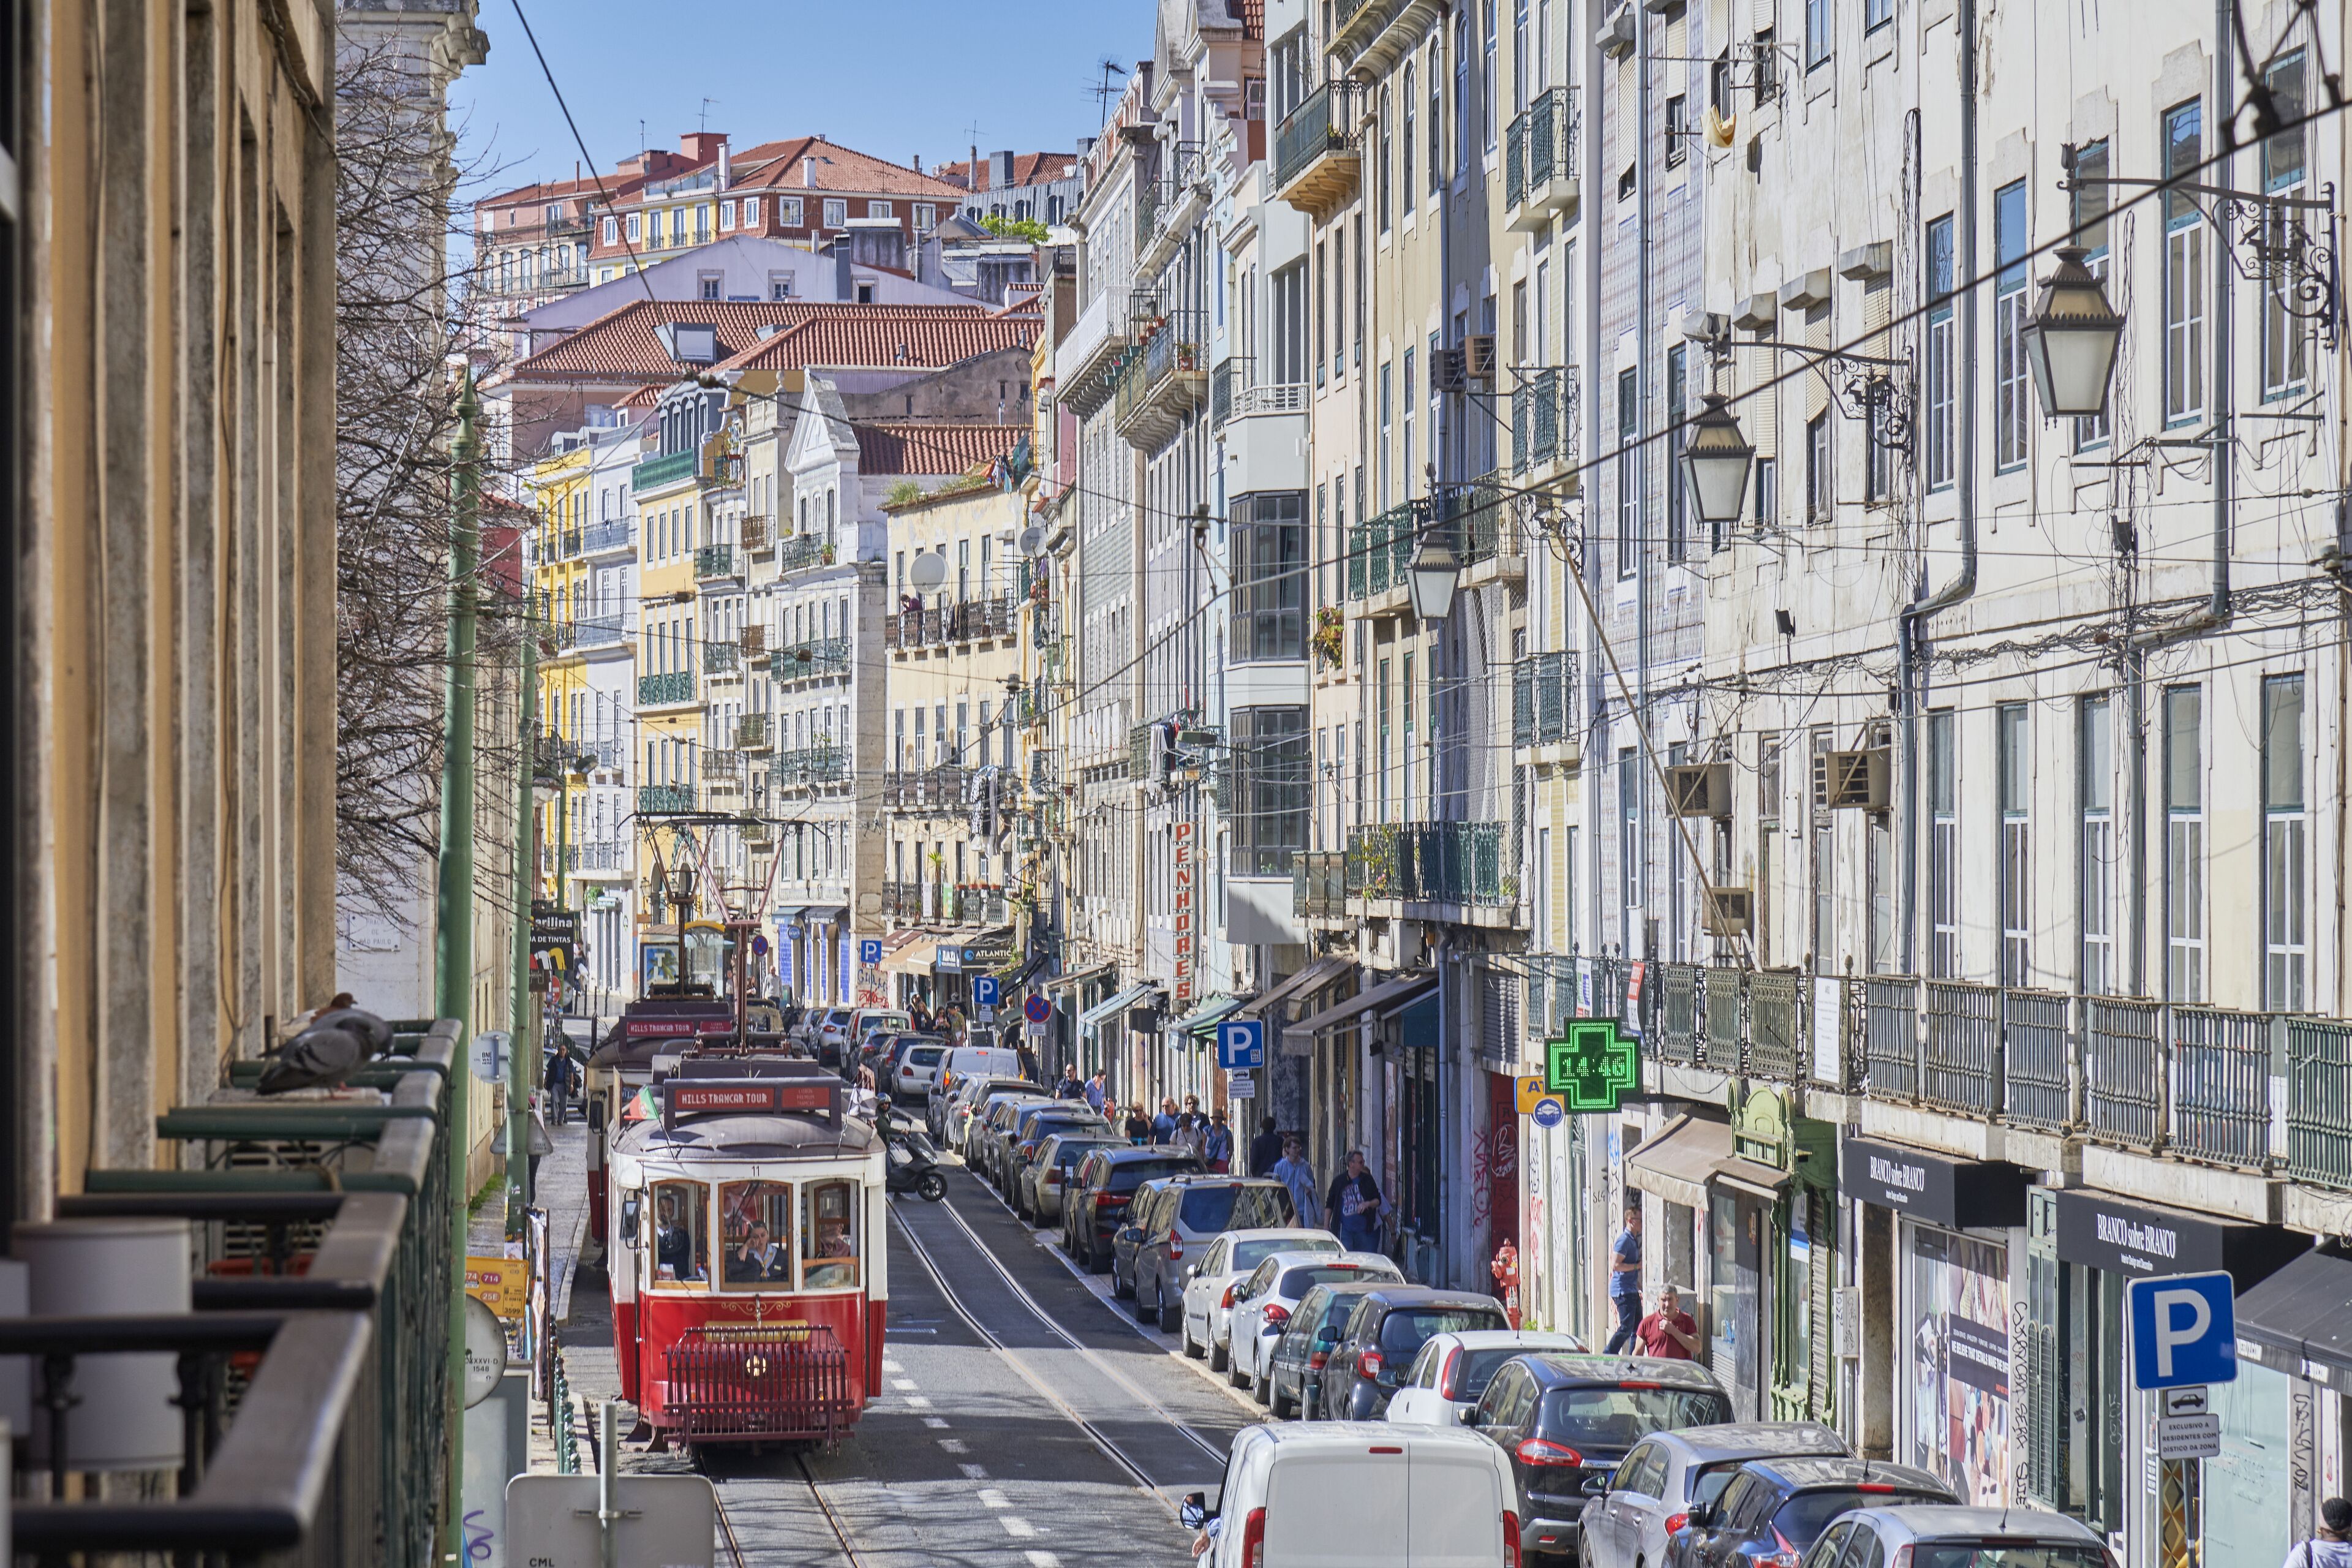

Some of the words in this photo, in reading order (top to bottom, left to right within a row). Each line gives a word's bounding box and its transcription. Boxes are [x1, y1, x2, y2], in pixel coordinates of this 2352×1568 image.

[1175, 823, 1191, 1000] PENHORES
[865, 942, 877, 960] P
[980, 980, 993, 1001] P
[649, 1024, 674, 1033] TRAMCAR
[1227, 1026, 1253, 1064] P
[1562, 1056, 1625, 1077] 14:46
[682, 1094, 706, 1104] HILLS
[708, 1093, 744, 1104] TRAMCAR
[746, 1093, 767, 1103] TOUR
[752, 1165, 760, 1177] 11
[1870, 1156, 1891, 1184] BRANCO
[1891, 1163, 1902, 1187] sobre
[2097, 1213, 2127, 1246] BRANCO
[2128, 1221, 2144, 1251] sobre
[2141, 1258, 2153, 1272] Decoration
[2154, 1289, 2211, 1378] P
[1951, 1340, 1956, 1354] WE
[1956, 1341, 1968, 1358] BELIEVE
[1975, 1349, 1988, 1366] DETAILS
[1988, 1354, 1997, 1370] MAKE
[530, 1558, 554, 1567] CML
